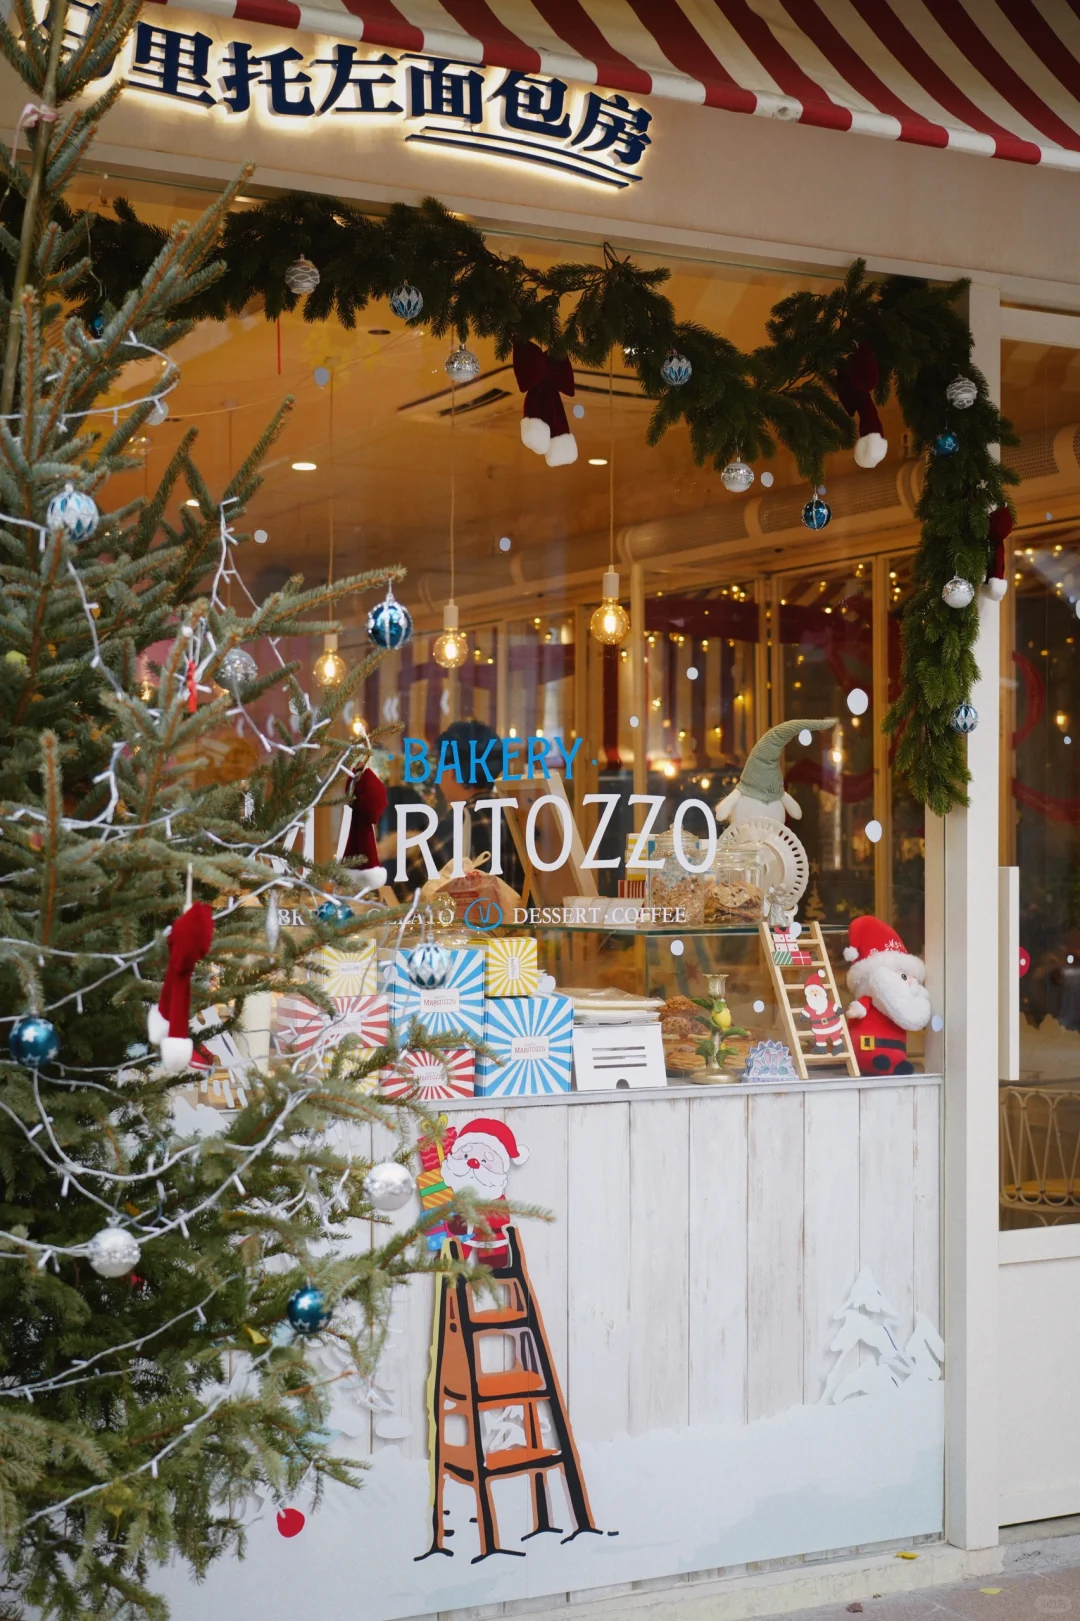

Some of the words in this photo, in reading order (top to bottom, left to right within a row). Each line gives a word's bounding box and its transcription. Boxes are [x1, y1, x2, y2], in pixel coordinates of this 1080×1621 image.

[403, 736, 584, 784] BAKERY
[513, 907, 601, 924] DESSERT
[612, 907, 687, 923] COFFEE
